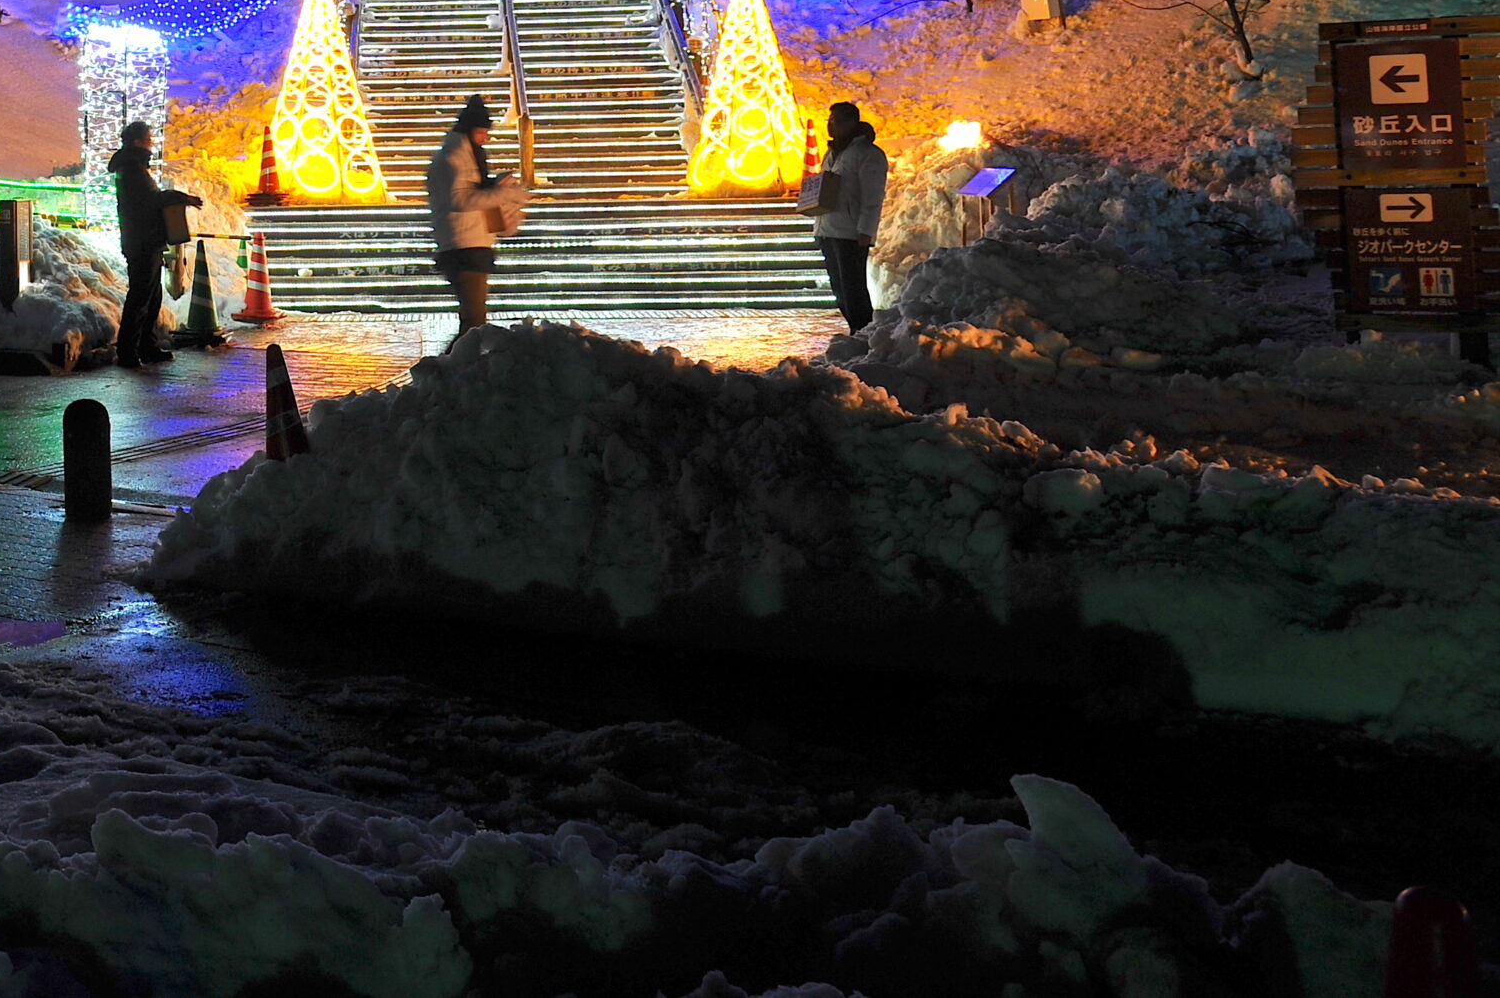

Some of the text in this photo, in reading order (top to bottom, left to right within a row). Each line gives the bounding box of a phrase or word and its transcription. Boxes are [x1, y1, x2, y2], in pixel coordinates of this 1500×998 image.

[1352, 114, 1453, 134] 砂丘入口
[1353, 138, 1454, 147] Sand Dunes Entrance
[1357, 239, 1463, 255] ジオパークセンター
